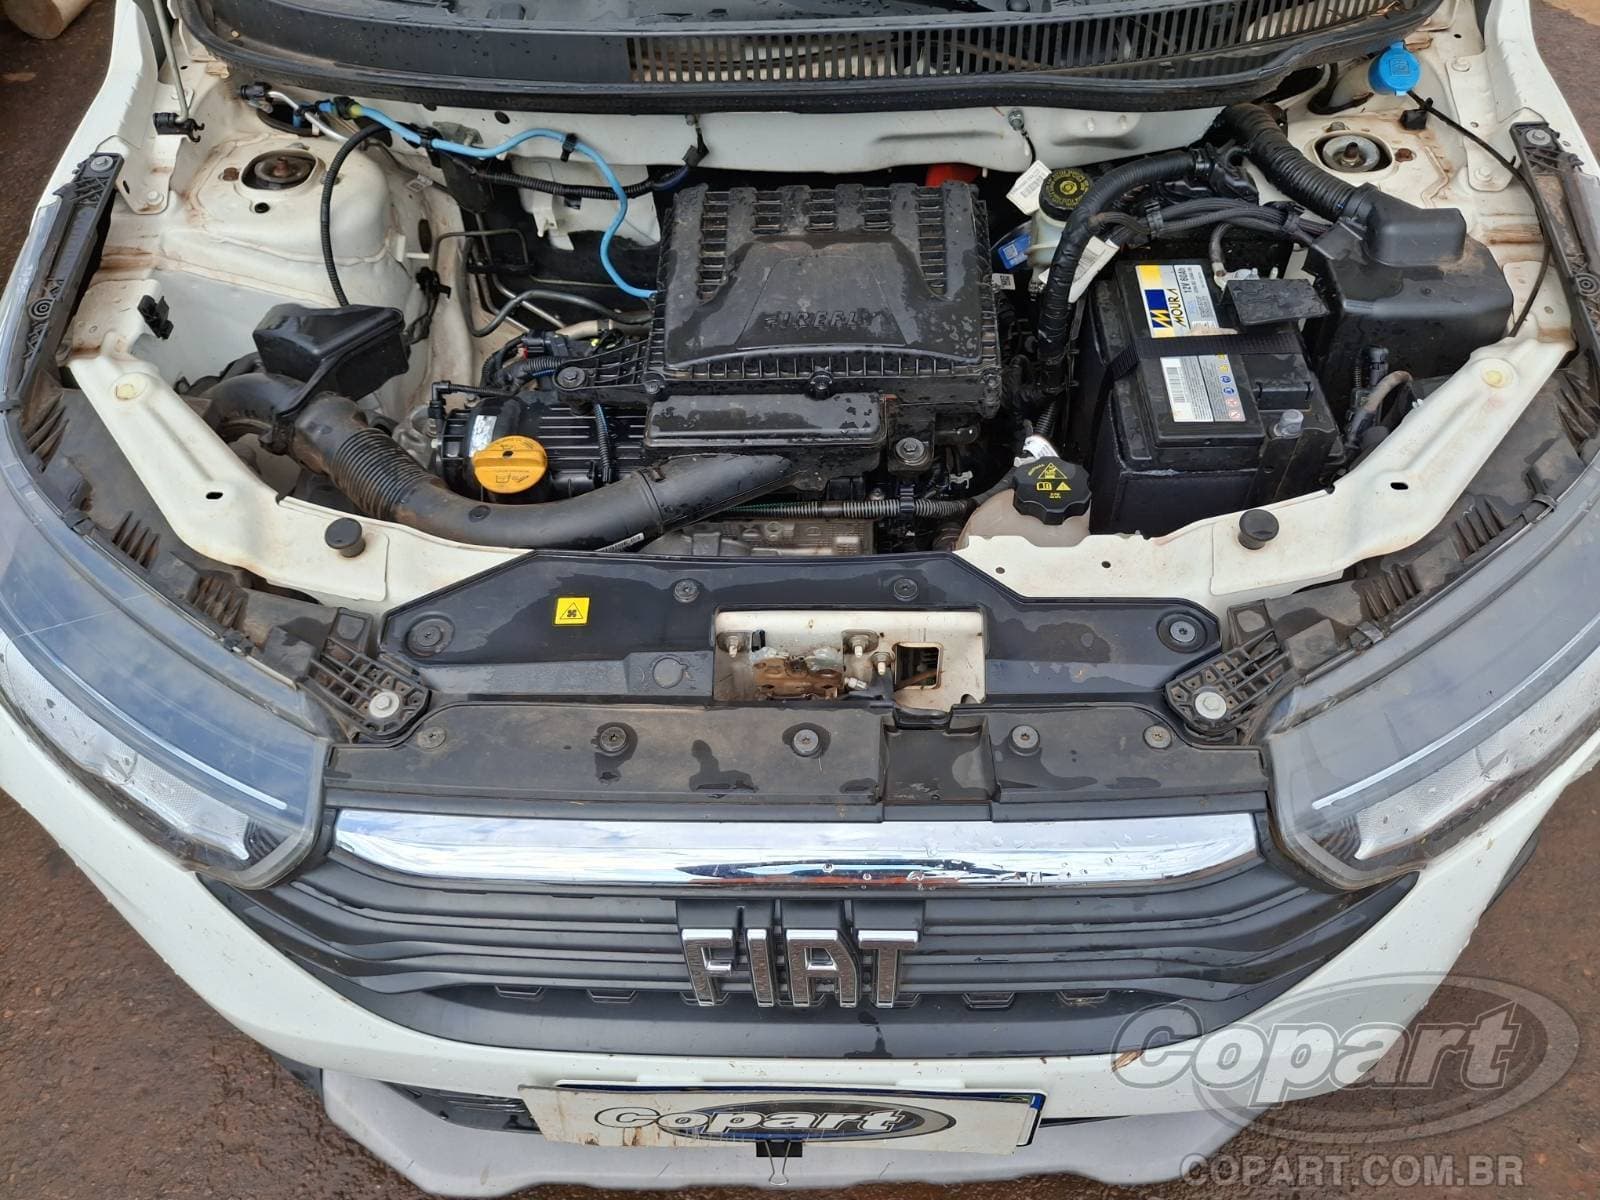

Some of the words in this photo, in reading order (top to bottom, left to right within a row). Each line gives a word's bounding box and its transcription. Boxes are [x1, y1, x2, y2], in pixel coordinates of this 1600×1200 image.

[1167, 288, 1187, 328] MOURA
[681, 928, 919, 1008] FIAT
[594, 1104, 908, 1134] Copart
